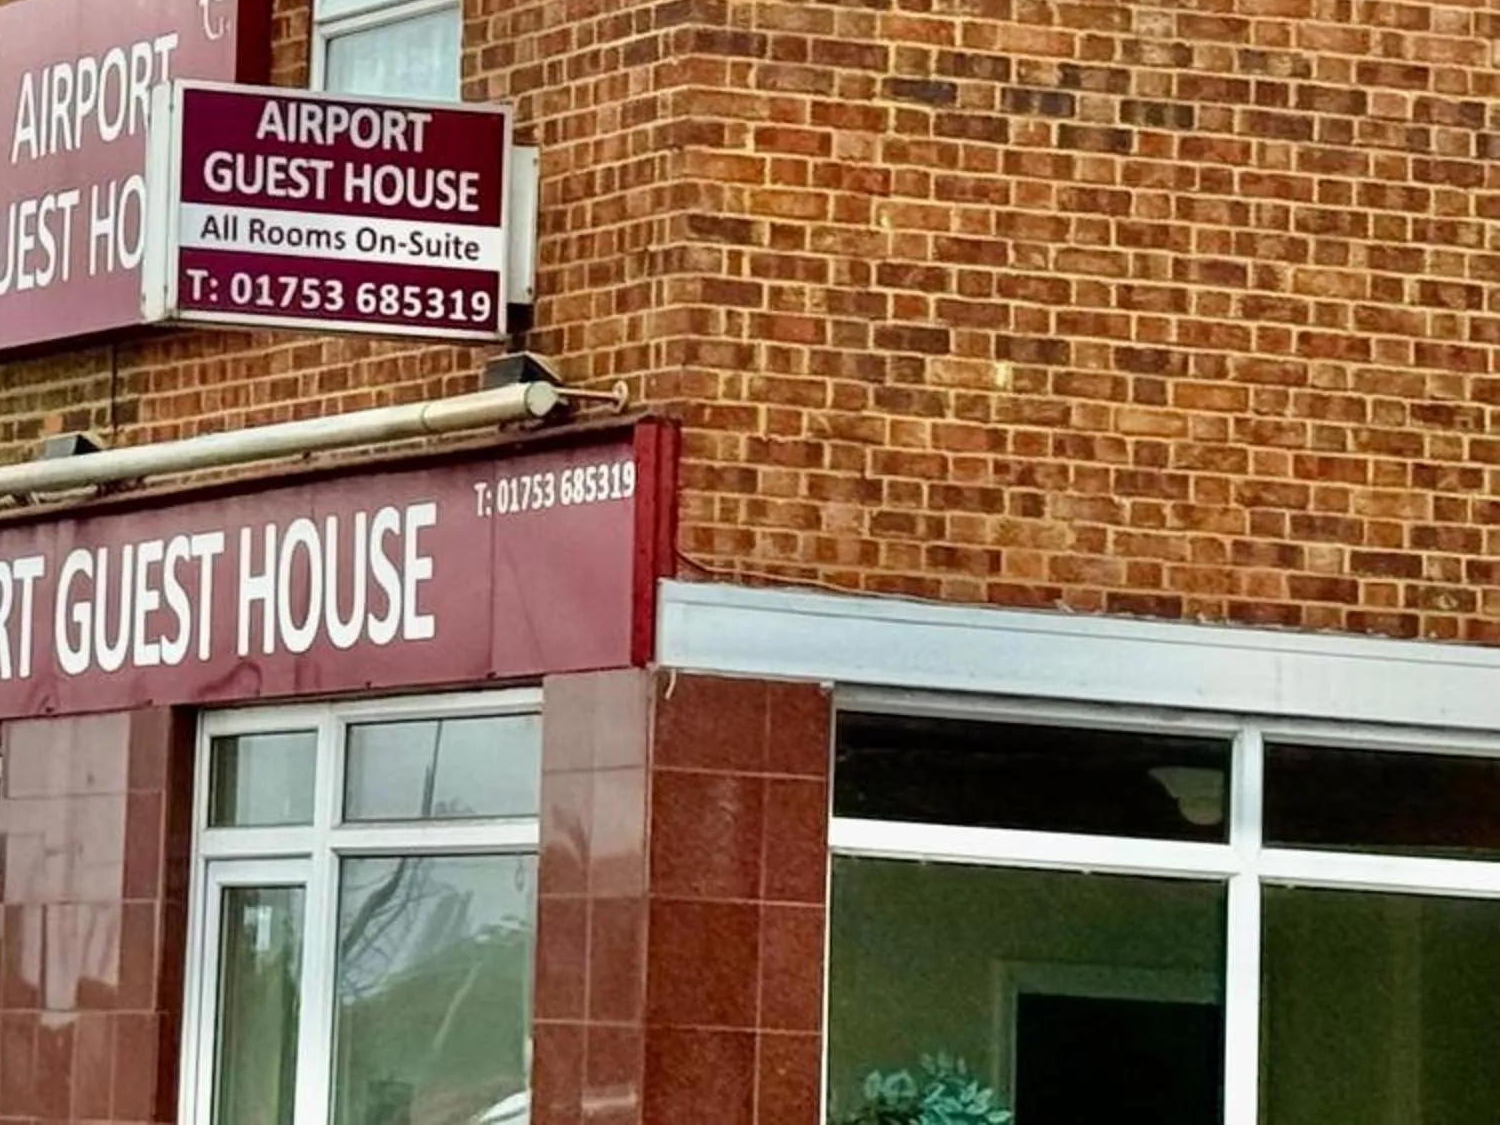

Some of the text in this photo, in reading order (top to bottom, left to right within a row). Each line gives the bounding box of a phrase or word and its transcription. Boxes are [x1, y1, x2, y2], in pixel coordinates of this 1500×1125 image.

[11, 32, 178, 165] AIRPORT
[256, 100, 433, 153] AIRPORT
[203, 150, 480, 212] GUEST HOUSE
[200, 214, 481, 261] All Rooms On-Suite
[186, 269, 492, 322] T: 01753 685319
[474, 460, 636, 517] T: 01753 685319
[55, 530, 223, 675] GUEST
[238, 502, 437, 656] HOUSE
